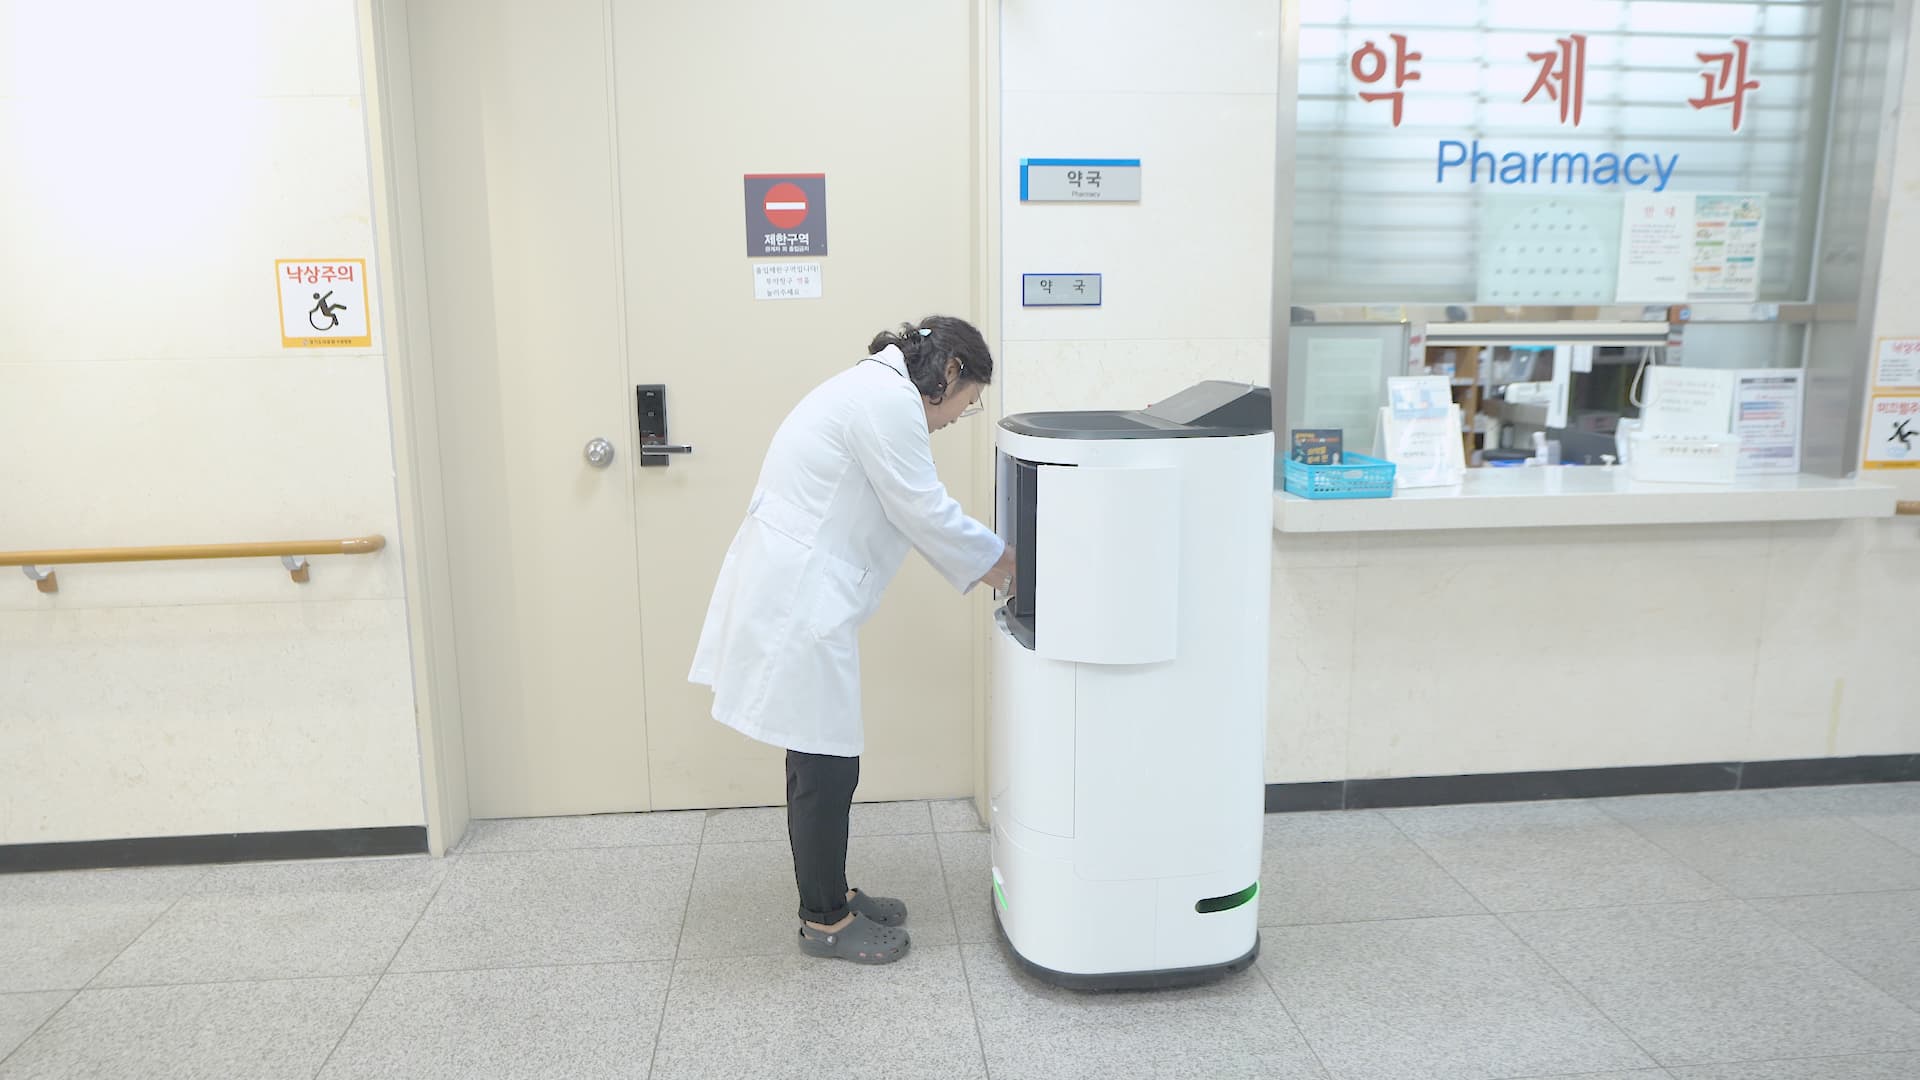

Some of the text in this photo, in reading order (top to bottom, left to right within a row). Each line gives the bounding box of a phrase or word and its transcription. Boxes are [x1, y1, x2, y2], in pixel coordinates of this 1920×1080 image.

[1351, 33, 1760, 133] 약 제 과
[1437, 139, 1680, 193] Pharmacy
[1067, 170, 1102, 188] 약국
[1071, 190, 1101, 198] Pharmacy
[764, 233, 809, 246] 제한구역
[286, 265, 354, 284] 낙상주의
